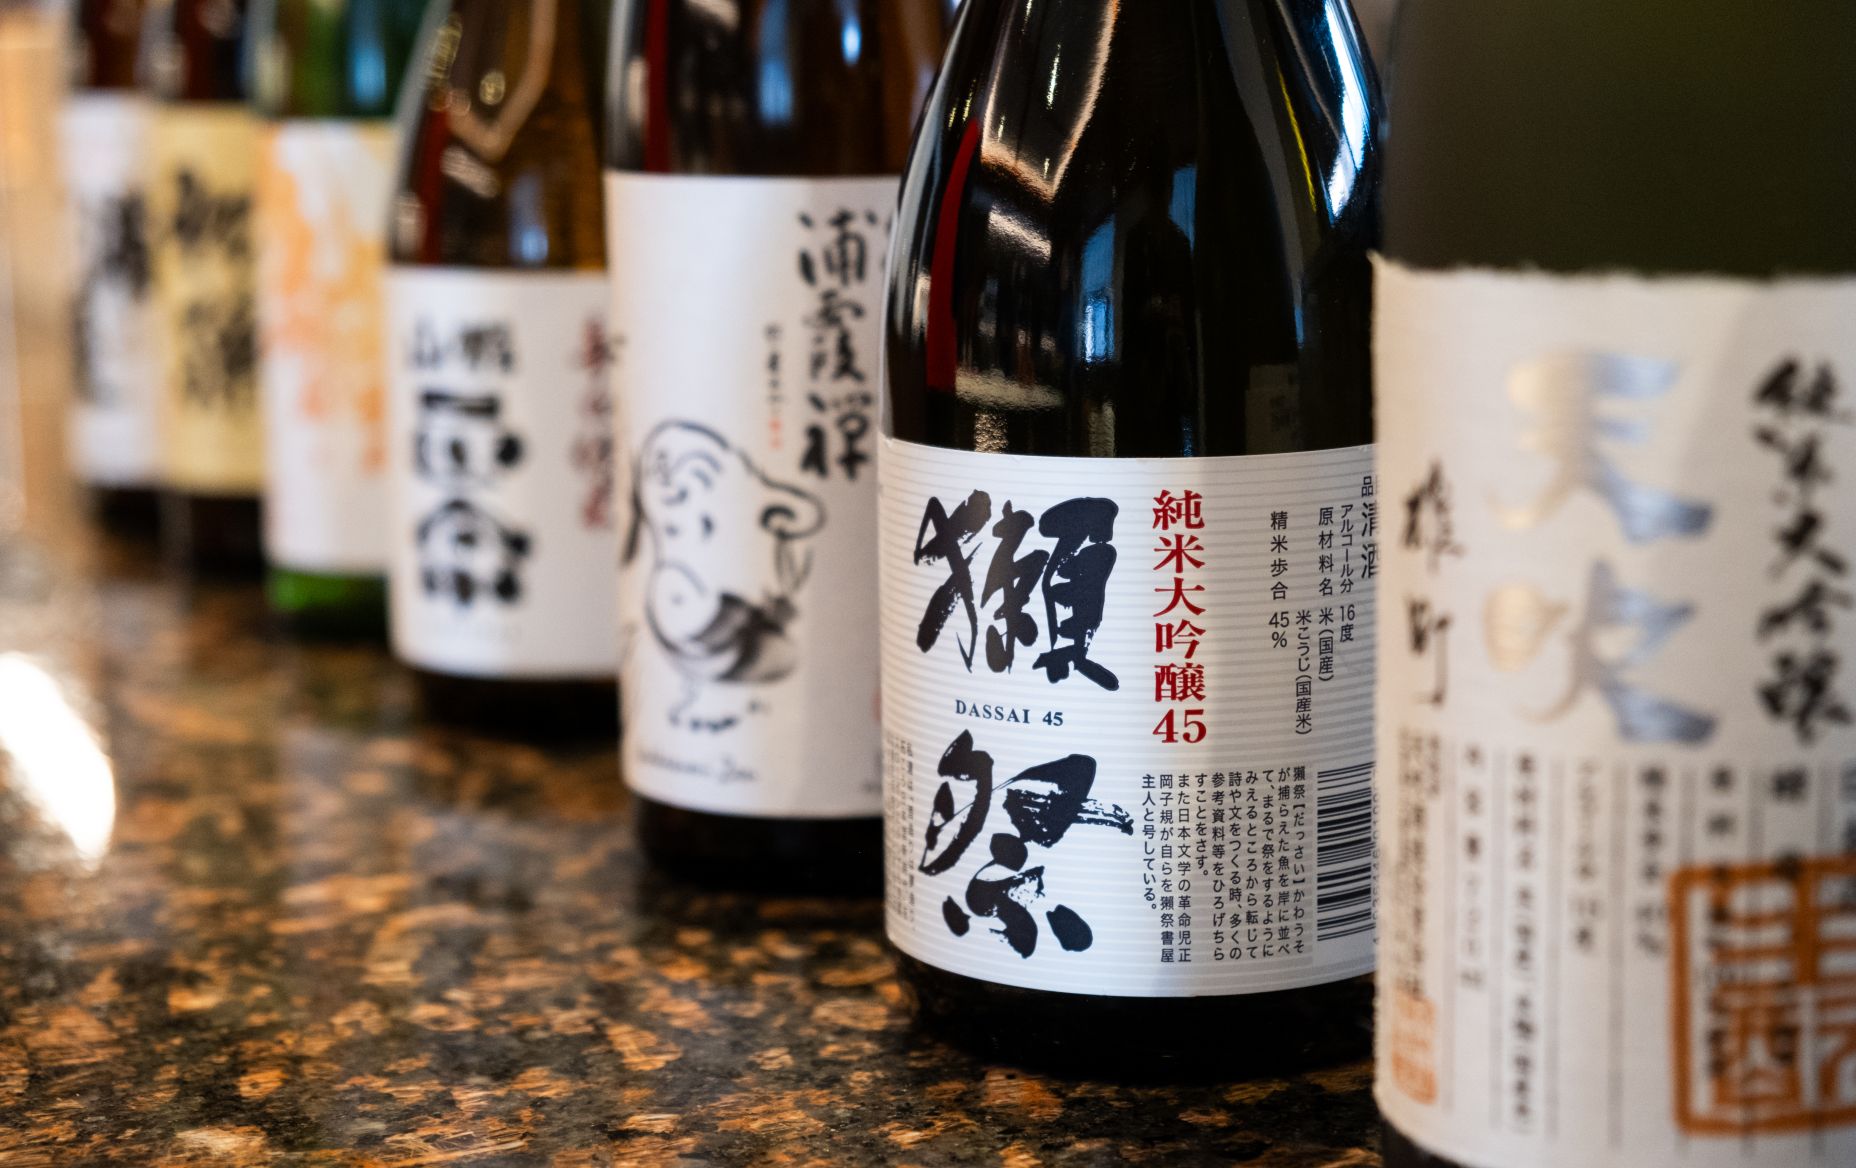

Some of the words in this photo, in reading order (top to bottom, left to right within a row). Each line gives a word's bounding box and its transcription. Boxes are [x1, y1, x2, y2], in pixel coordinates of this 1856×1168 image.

[1270, 511, 1288, 600] 精米歩合
[1318, 507, 1334, 597] 原材料名
[1340, 504, 1355, 594] アルコール分
[1340, 604, 1355, 643] 16度
[955, 699, 1030, 724] DASSAI
[1043, 711, 1064, 728] 45
[1142, 774, 1157, 910] 主人と号している。
[1160, 774, 1174, 963] 岡子規が自らを獺祭書屋
[1178, 774, 1192, 962] また日本文学の革命児正
[1195, 773, 1208, 877] すことをさす。
[1212, 772, 1225, 961] 参考資料等をひろげちら
[1229, 772, 1242, 960] 詩や文をつくる時、多くの
[1246, 771, 1259, 958] みえるところから転じて
[1262, 769, 1275, 957] て、まるで祭をするように
[1277, 767, 1291, 954] が捕らえた魚を岸に並べ
